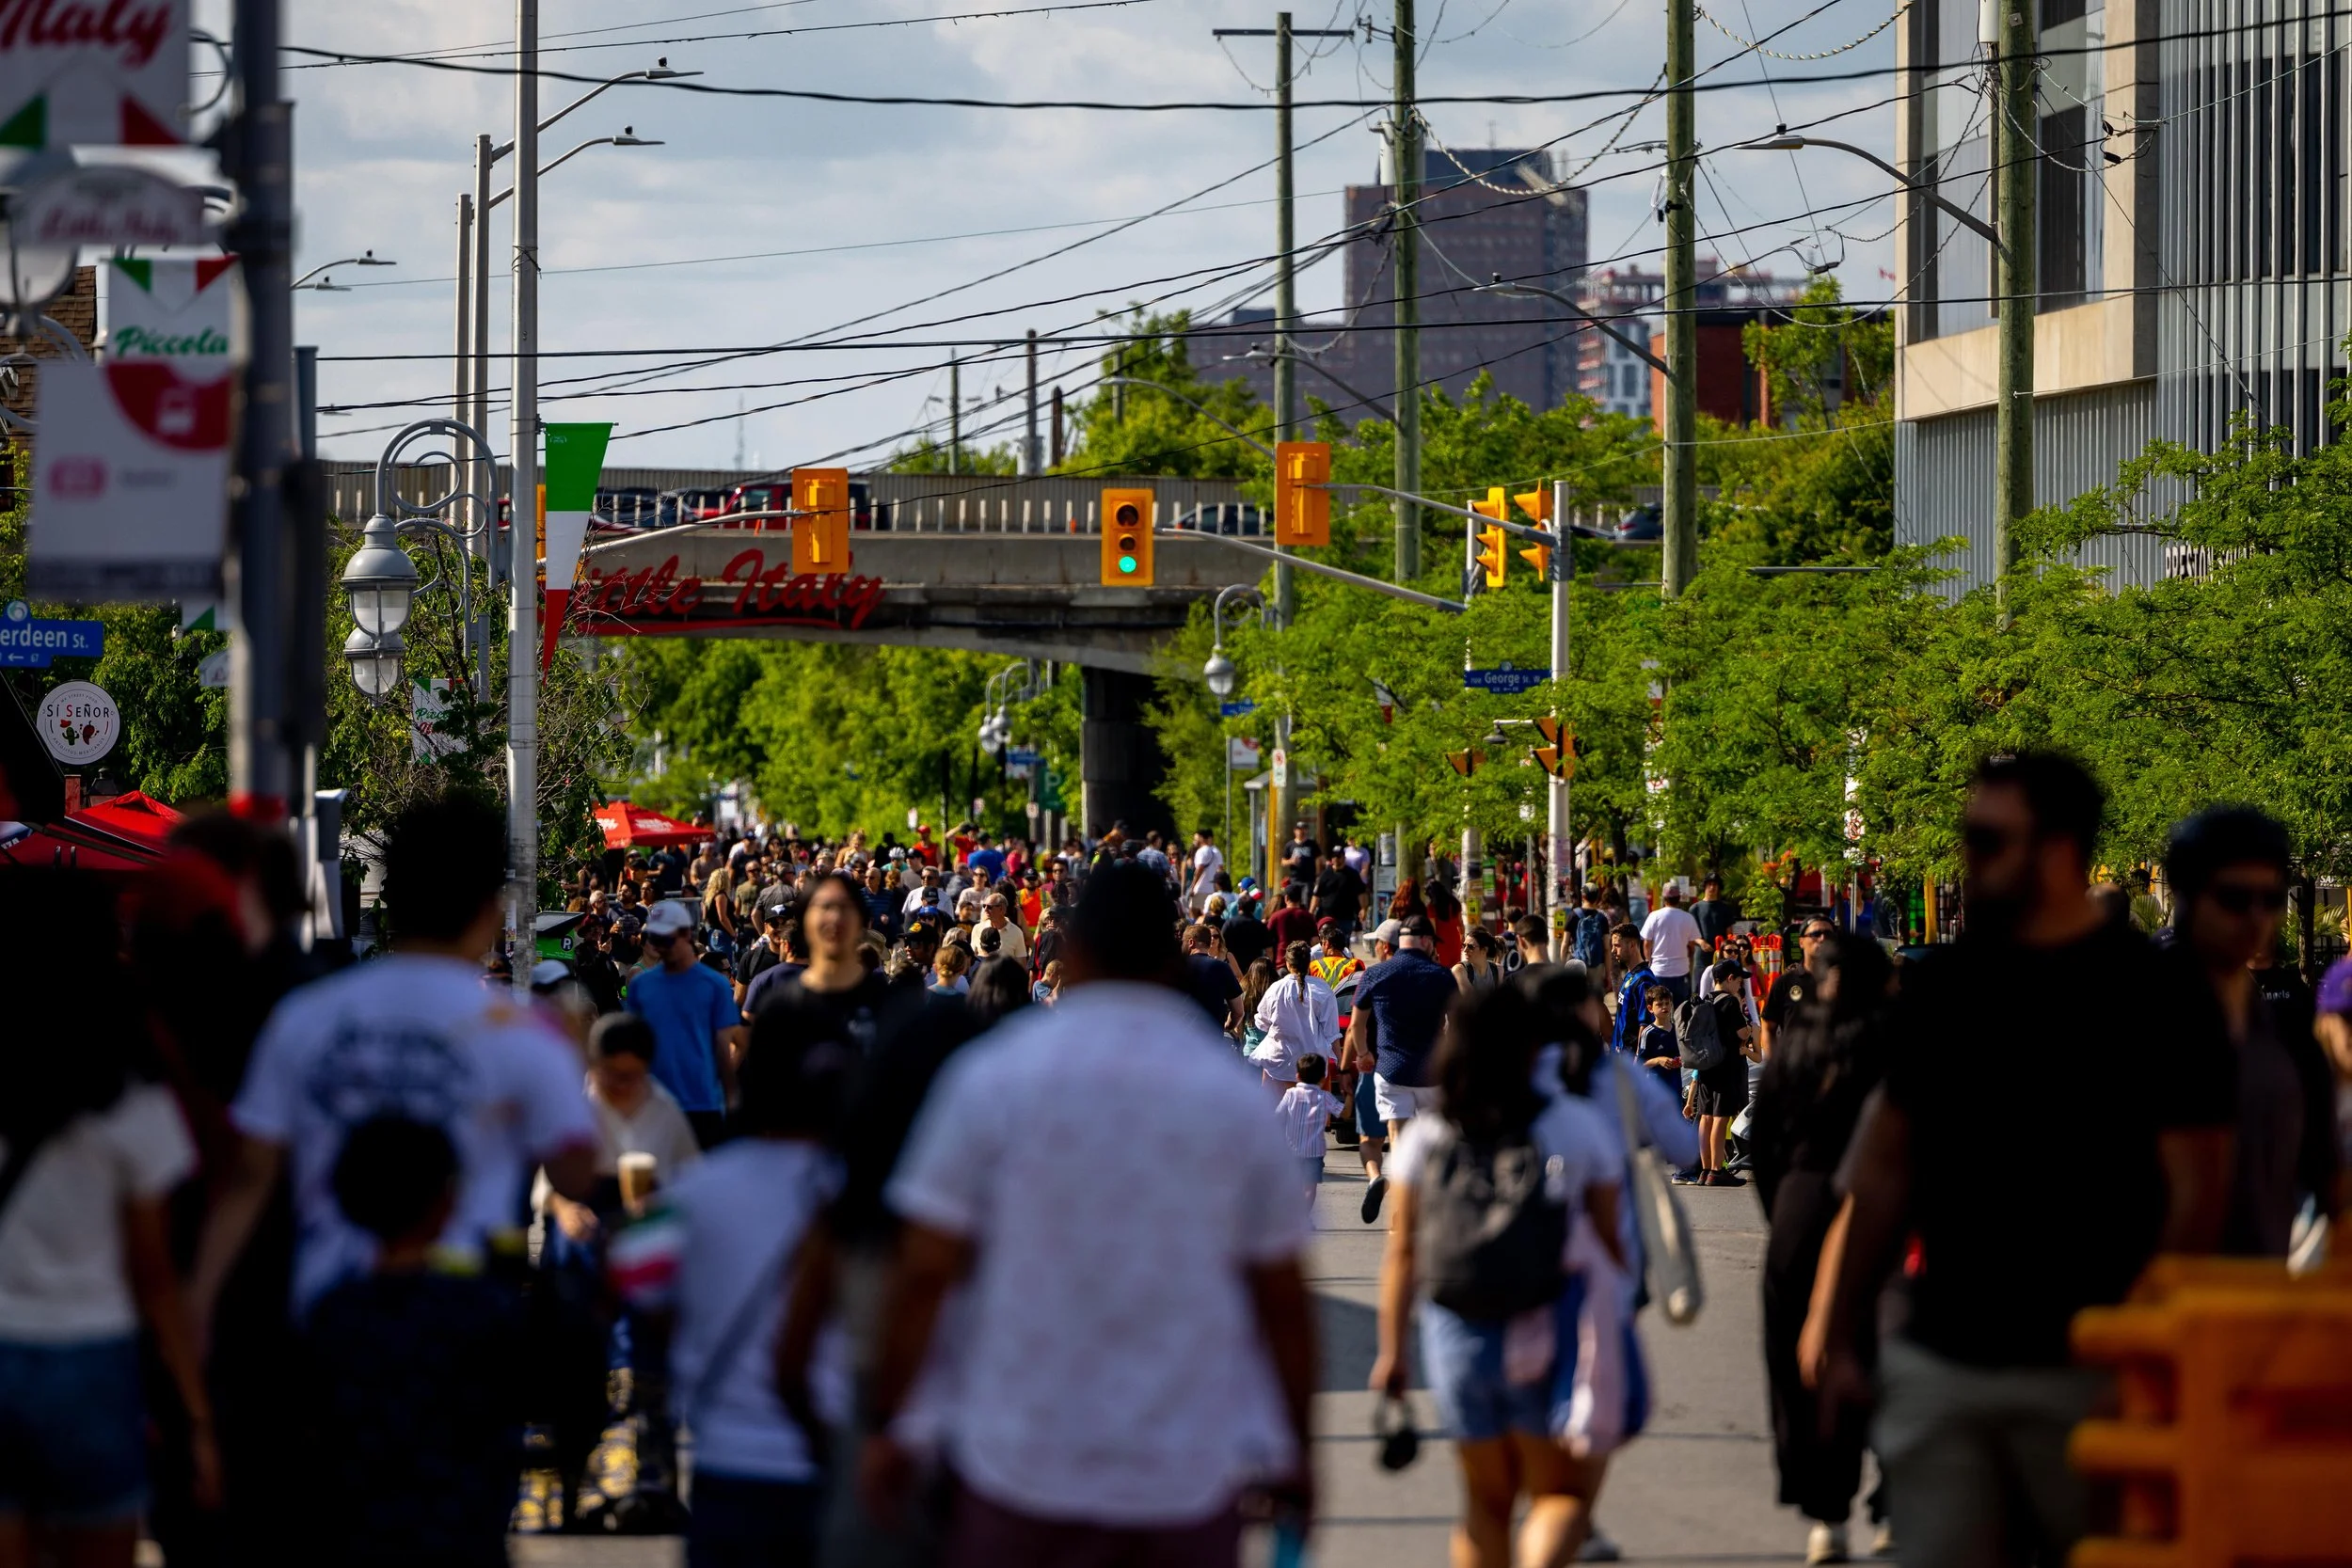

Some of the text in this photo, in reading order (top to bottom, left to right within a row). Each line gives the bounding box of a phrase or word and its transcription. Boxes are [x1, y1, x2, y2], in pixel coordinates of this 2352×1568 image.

[115, 325, 229, 358] Piccola
[570, 553, 704, 618] ittle
[0, 623, 89, 649] erdeen St.
[1484, 672, 1520, 687] George
[66, 703, 110, 718] SEÑOR
